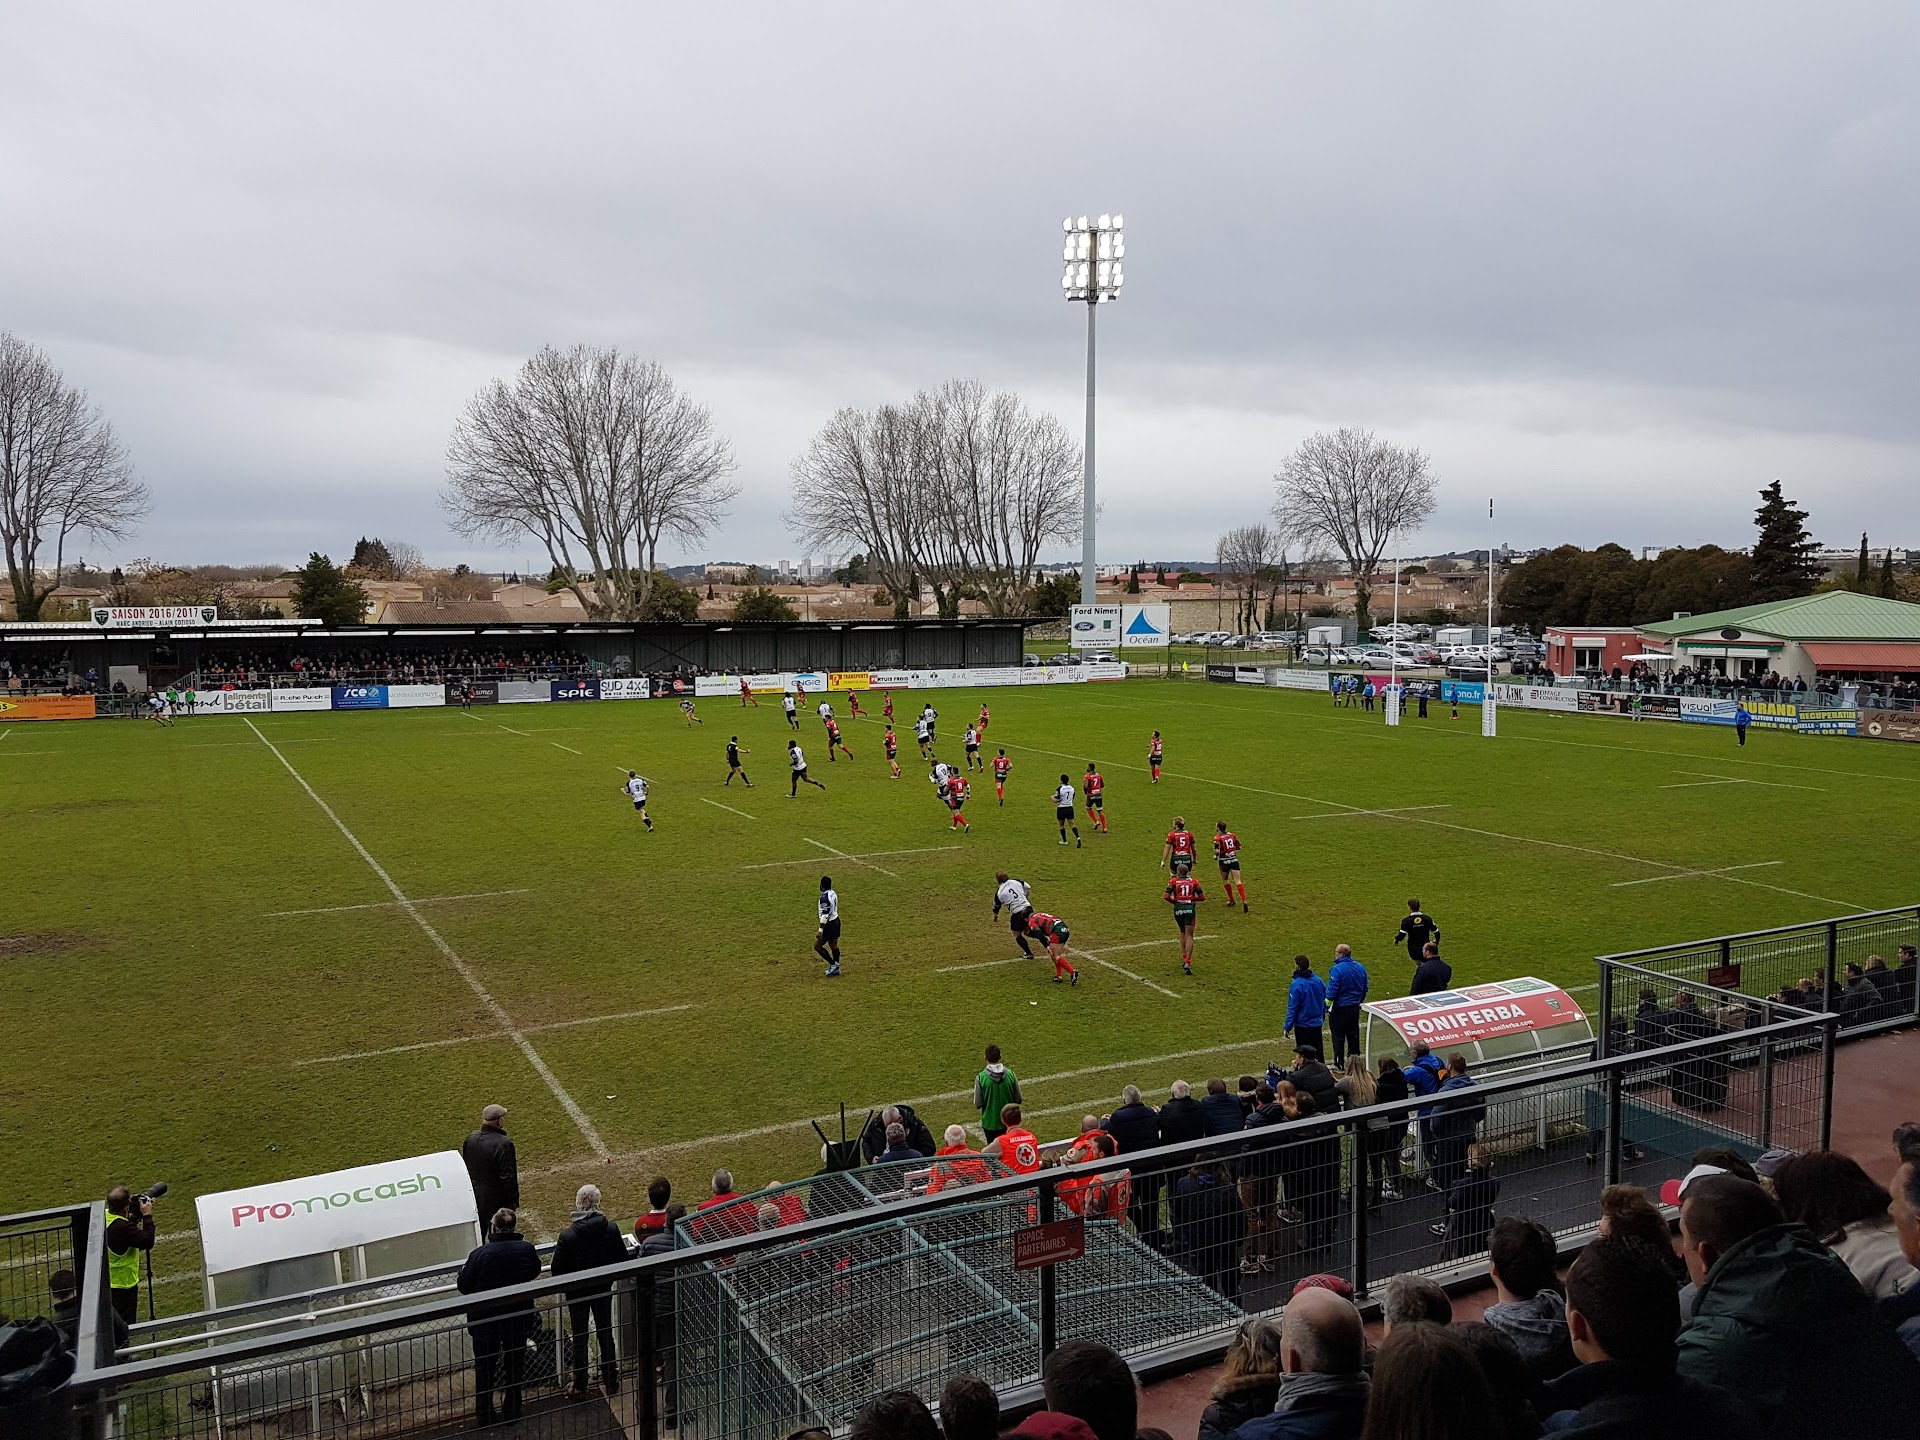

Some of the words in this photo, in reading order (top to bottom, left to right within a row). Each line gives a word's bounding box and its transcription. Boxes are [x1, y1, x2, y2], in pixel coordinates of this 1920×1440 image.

[112, 609, 145, 619] SAISON
[149, 608, 199, 619] 2016/2017
[1129, 636, 1159, 644] Océan
[601, 680, 623, 692] SUD
[557, 688, 594, 698] SPIE
[223, 692, 271, 711] bétail
[1093, 778, 1098, 787] 7
[1179, 837, 1186, 847] 5
[1225, 838, 1235, 850] 13
[1008, 888, 1019, 899] 3
[1180, 884, 1190, 897] 11
[1402, 1003, 1526, 1036] SONIFERBA
[1423, 1036, 1433, 1044] Bd
[1434, 1032, 1460, 1043] Natoire
[1490, 1019, 1534, 1032] soniferba.com
[231, 1173, 442, 1228] Promocash
[1017, 1228, 1045, 1245] ESPACE
[1017, 1236, 1066, 1258] PARTENAIRES
